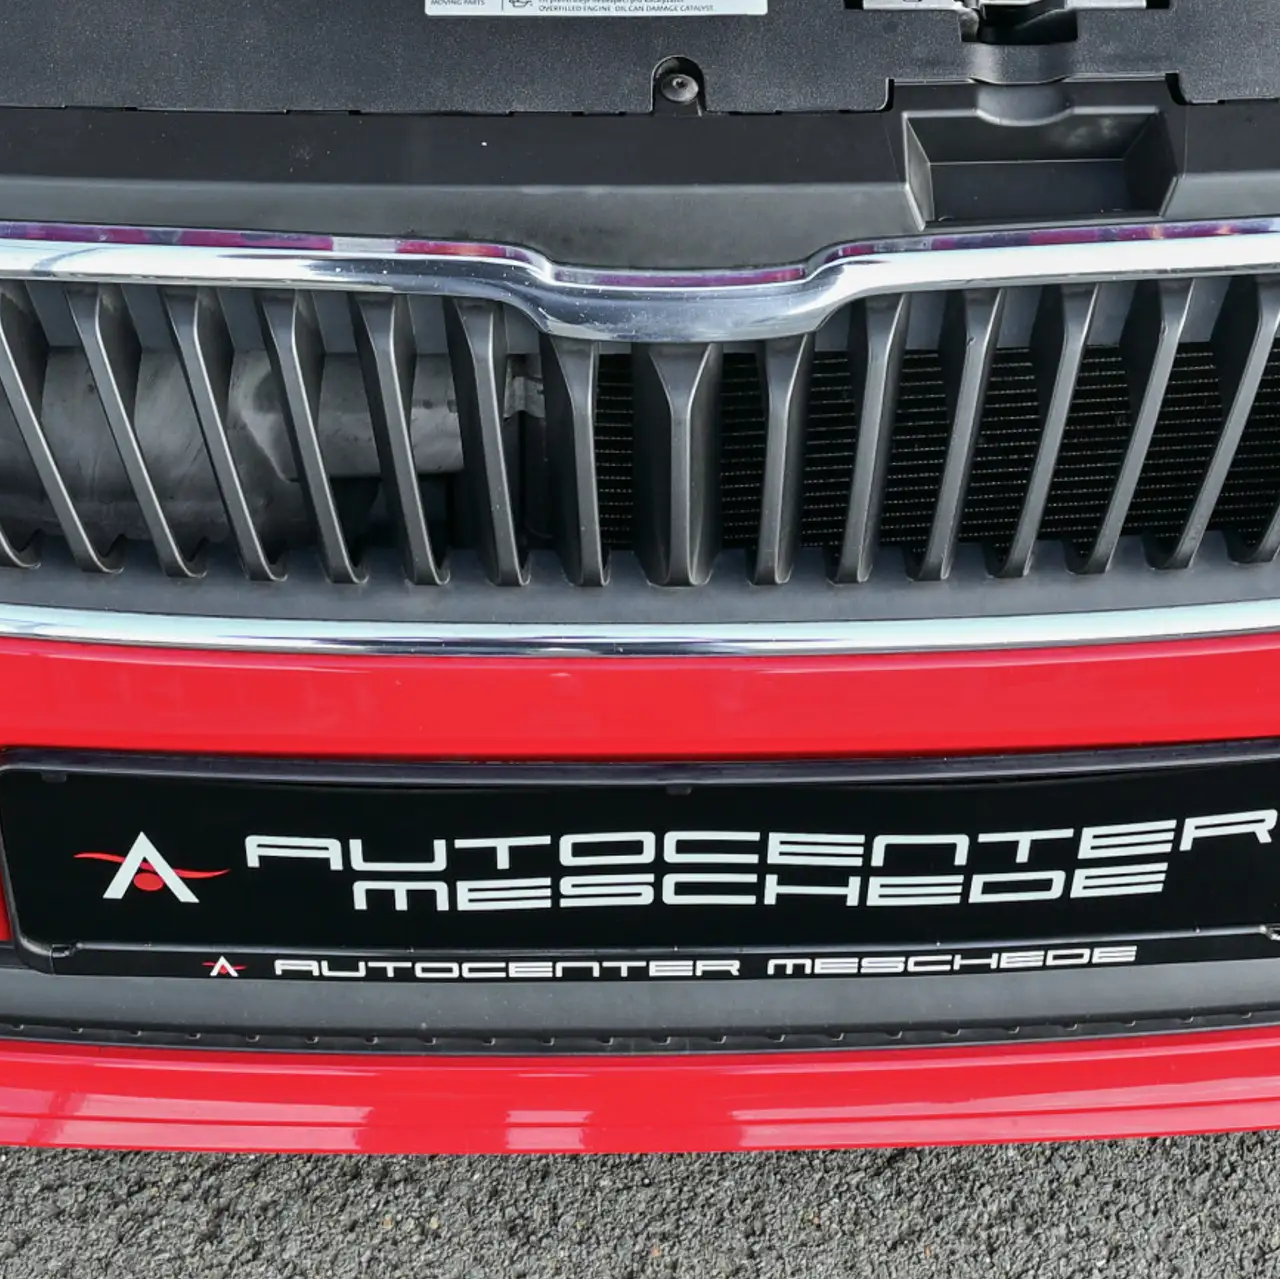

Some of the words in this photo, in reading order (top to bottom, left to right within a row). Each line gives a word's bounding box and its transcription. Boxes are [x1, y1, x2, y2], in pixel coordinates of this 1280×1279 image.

[245, 809, 1278, 872] AUTOCENTER
[352, 862, 1169, 912] MESCHEDE
[274, 959, 741, 979] AUTOCENTER
[766, 945, 1138, 976] MESCHEDE
